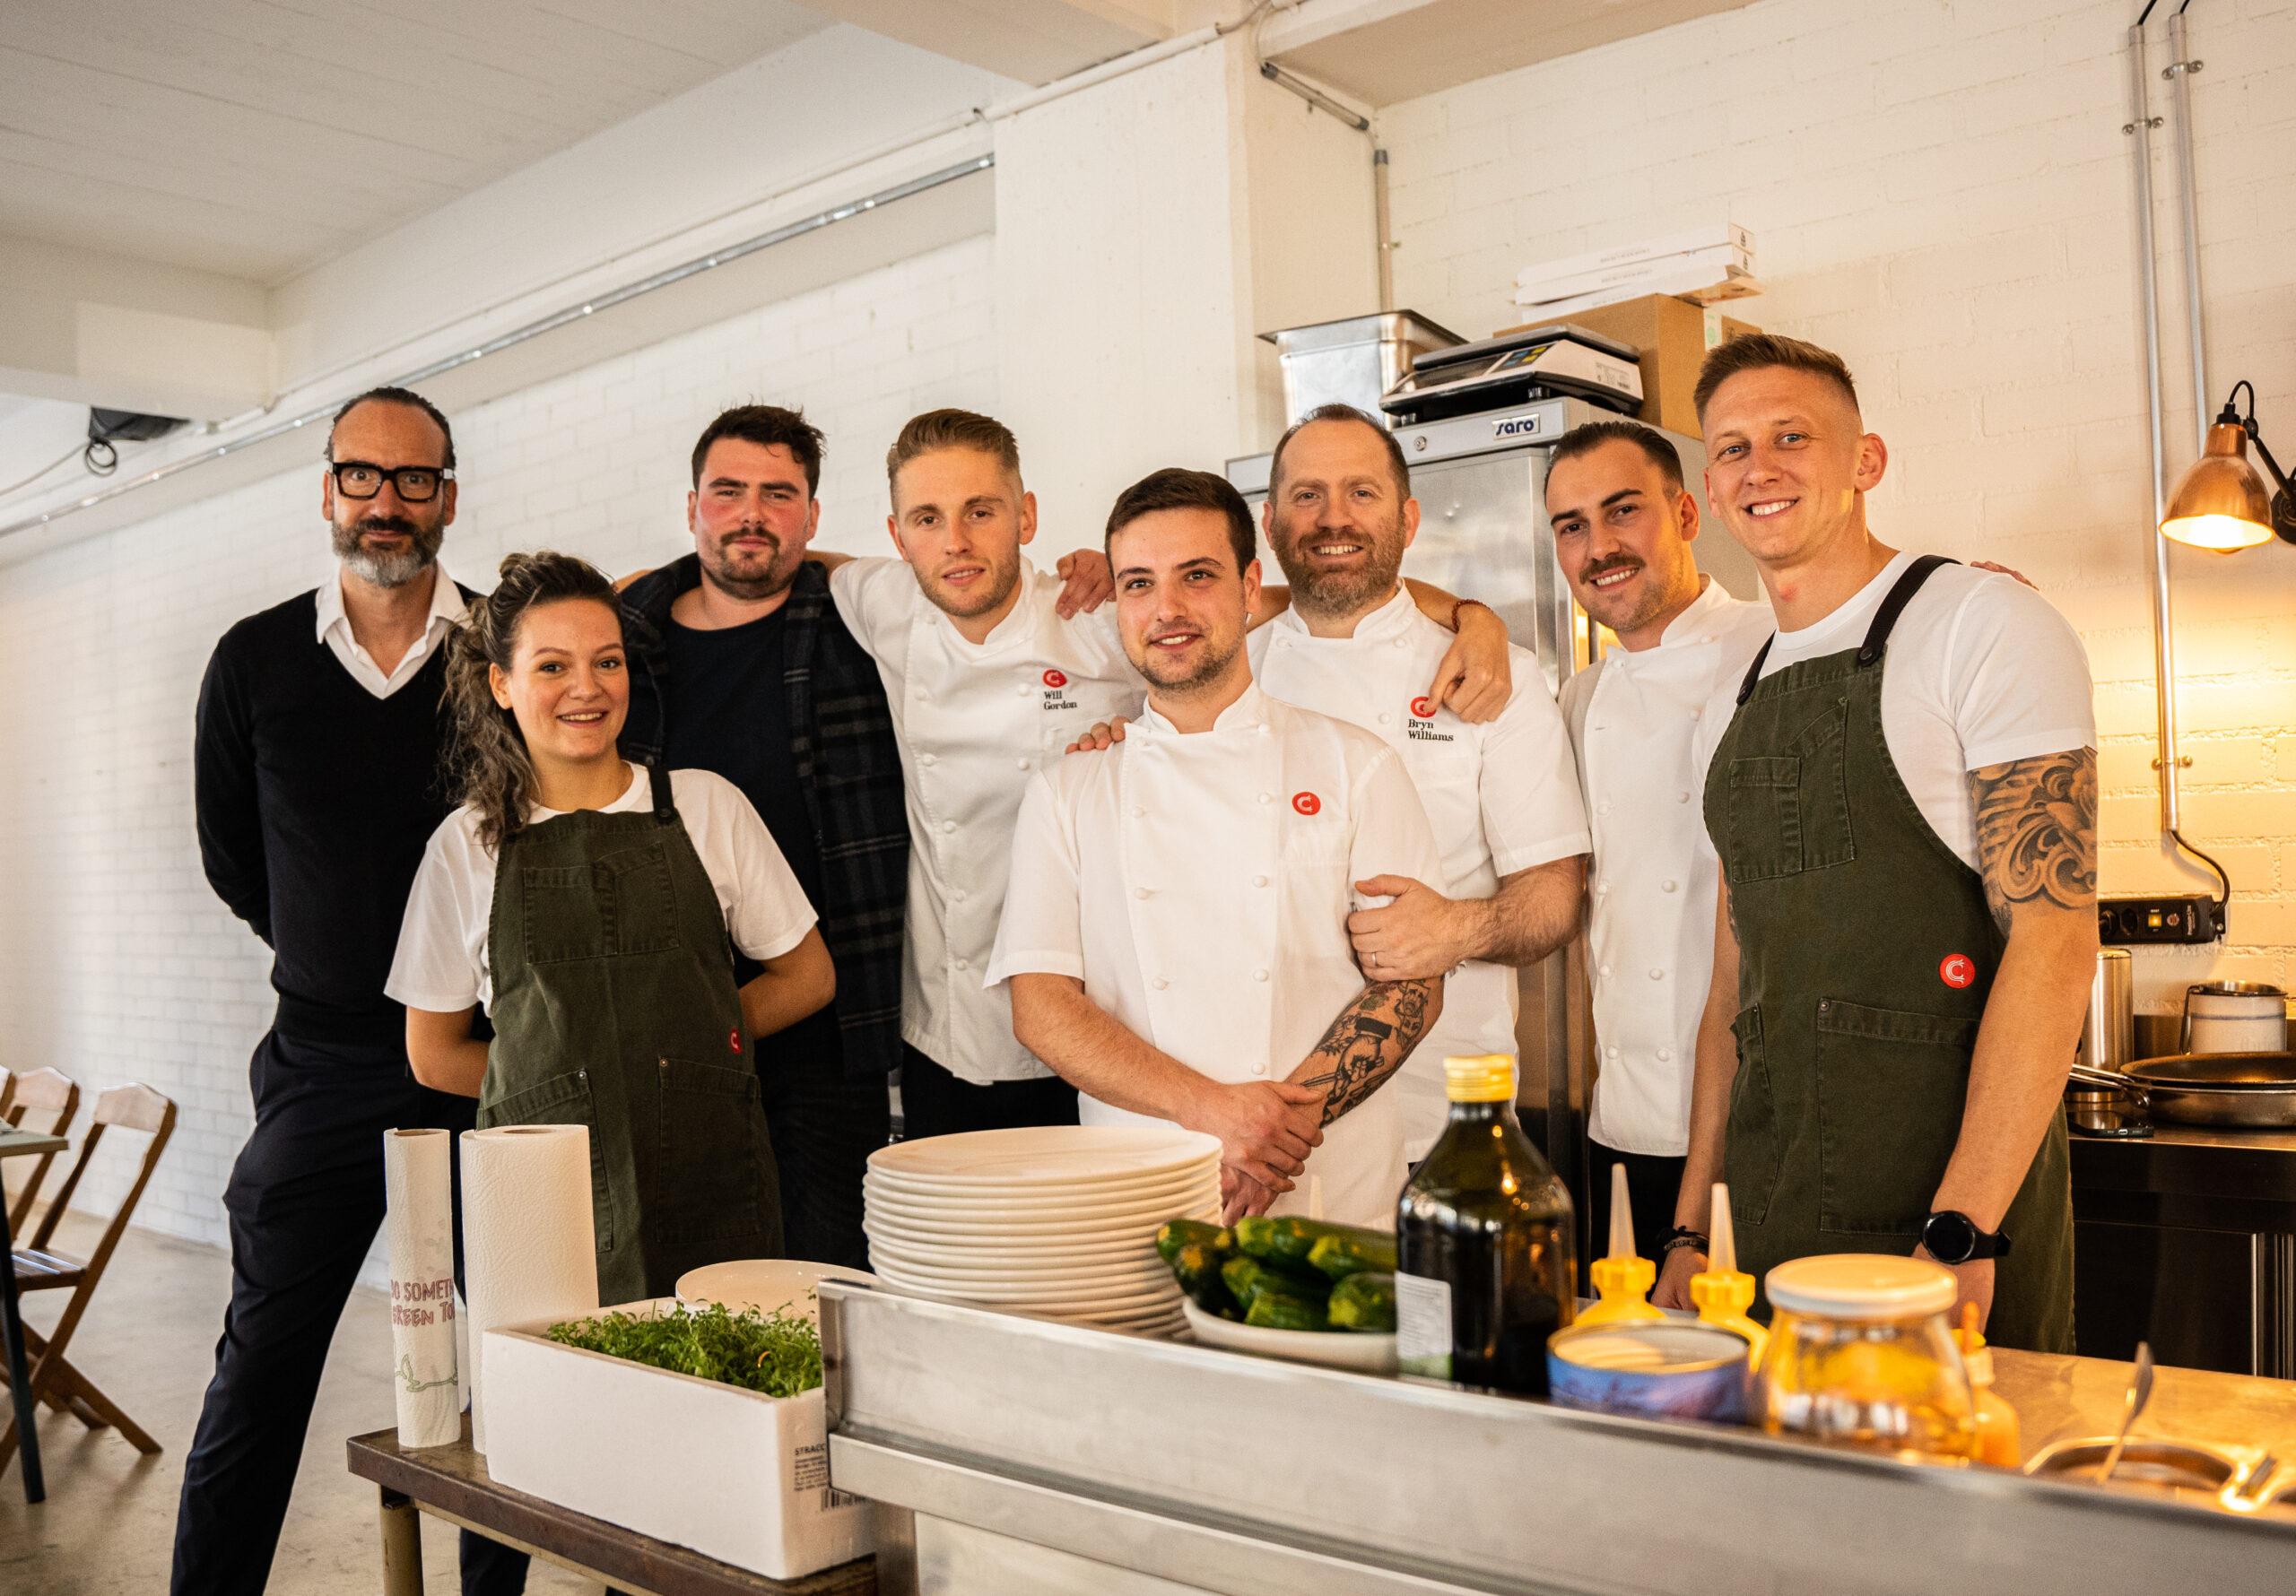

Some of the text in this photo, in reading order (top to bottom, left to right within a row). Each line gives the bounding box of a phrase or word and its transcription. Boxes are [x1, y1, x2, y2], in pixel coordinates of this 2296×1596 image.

[1496, 420, 1535, 436] saro
[1044, 690, 1062, 699] Will
[1044, 700, 1077, 710] Gordon
[1408, 718, 1434, 731] Bryn
[1408, 730, 1454, 742] Williams
[1945, 958, 1965, 984] C
